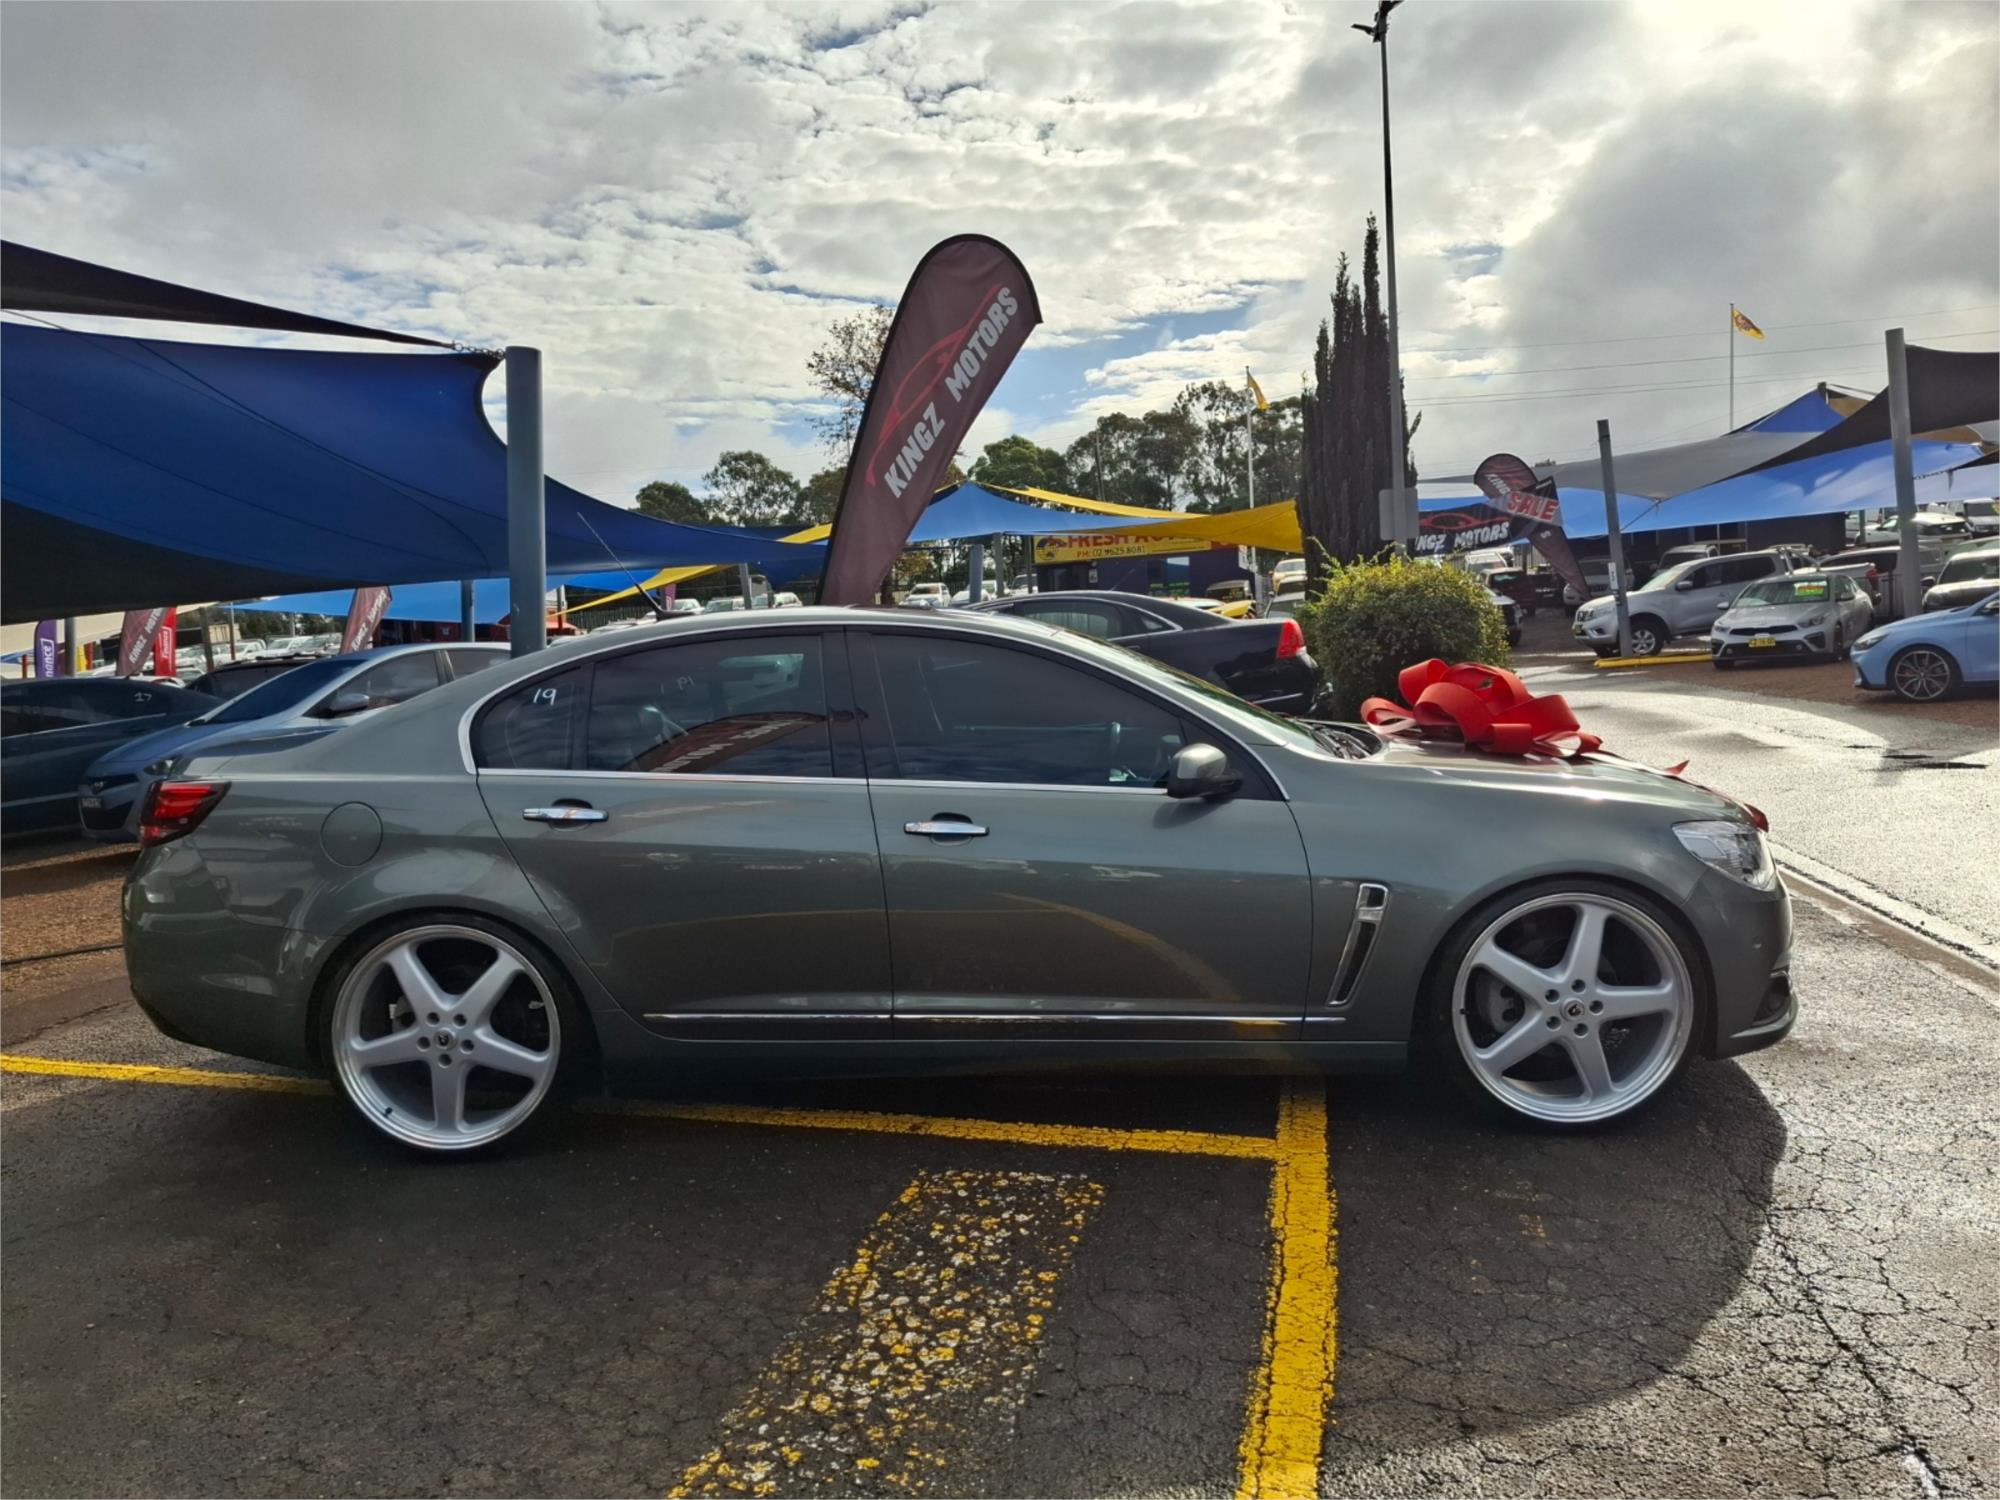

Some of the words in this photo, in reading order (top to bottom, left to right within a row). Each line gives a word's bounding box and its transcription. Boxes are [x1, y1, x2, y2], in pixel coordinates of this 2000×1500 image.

[884, 402, 945, 498] KINGZ
[945, 286, 1019, 402] MOTORS
[1484, 473, 1511, 496] KING
[1508, 492, 1559, 521] SALE
[1415, 533, 1448, 551] NGZ
[1454, 521, 1510, 548] MOTORS
[42, 645, 54, 677] nance
[128, 635, 148, 664] KINGZ
[533, 688, 557, 706] 19
